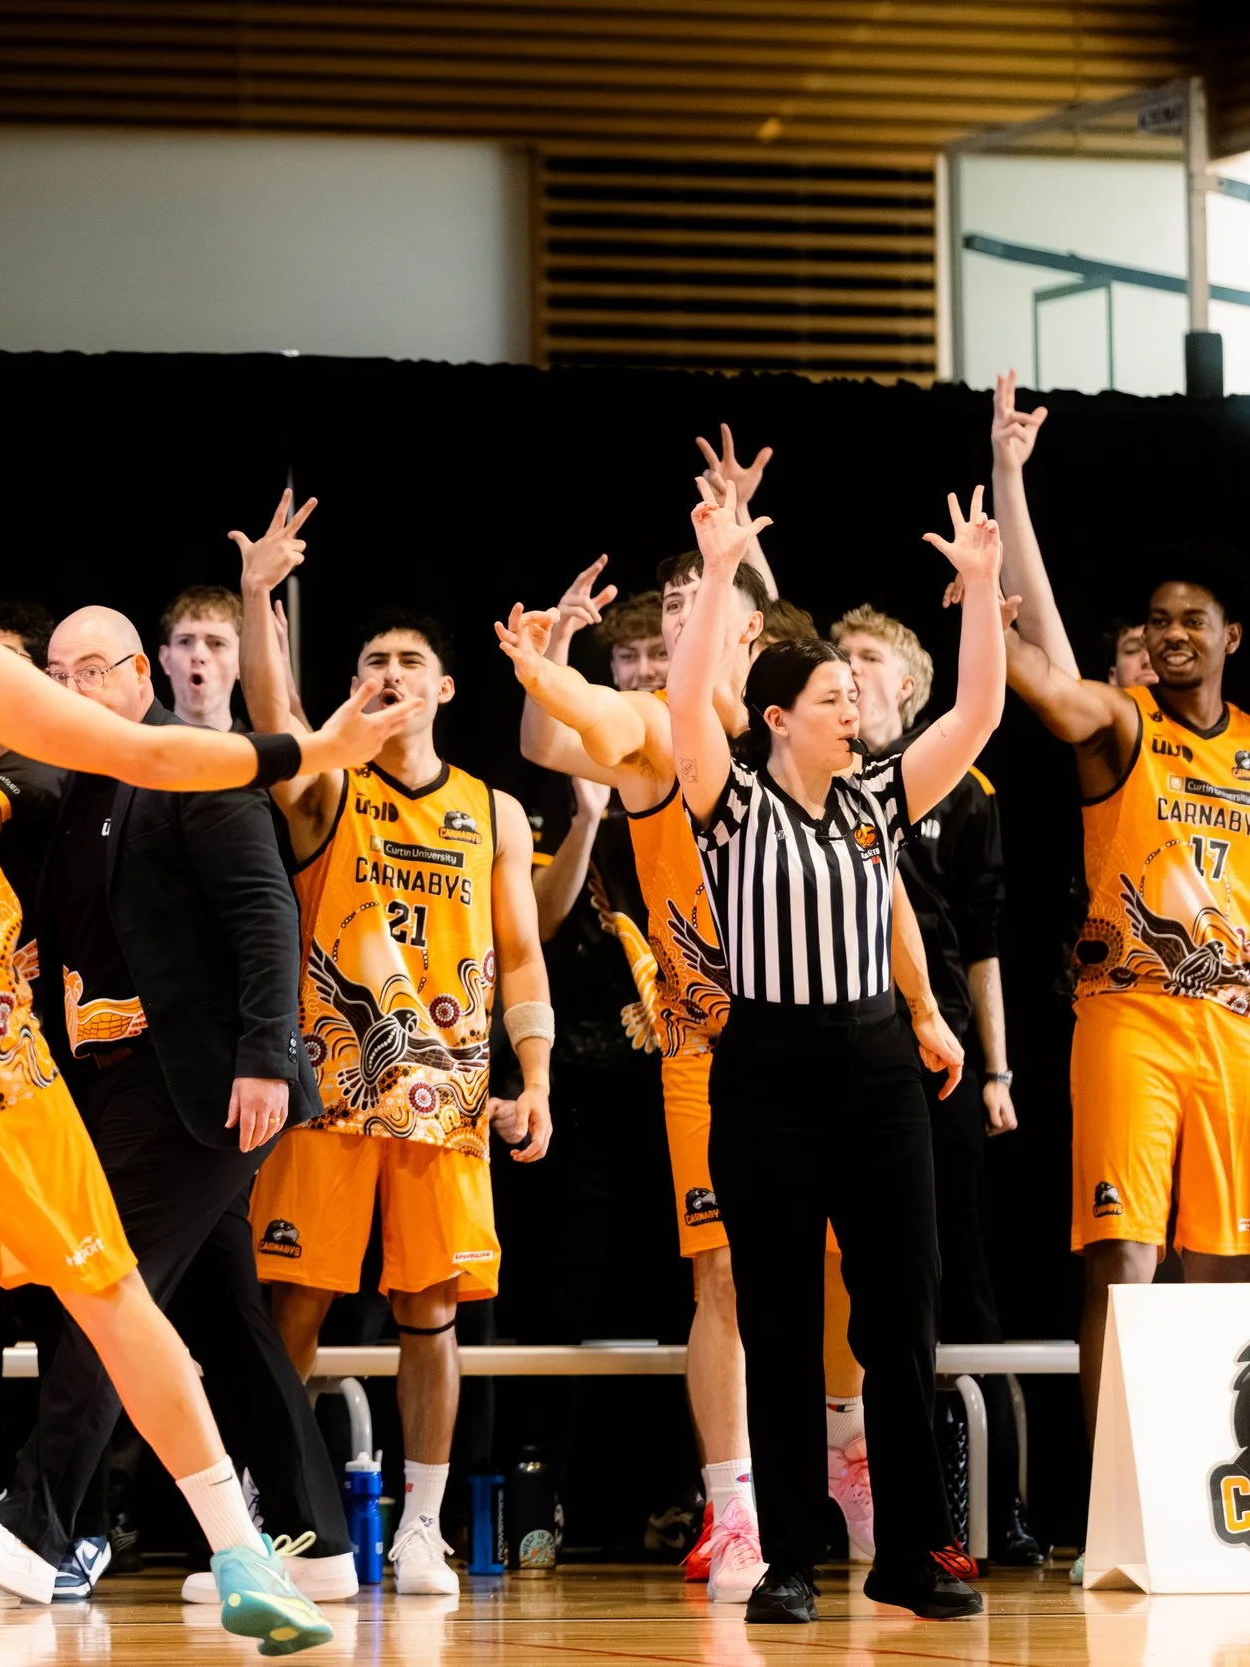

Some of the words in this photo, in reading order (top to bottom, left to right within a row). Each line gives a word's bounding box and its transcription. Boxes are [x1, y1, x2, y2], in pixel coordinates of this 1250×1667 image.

[385, 843, 412, 857] Curtin
[412, 849, 457, 864] University
[1191, 835, 1230, 879] 17
[355, 856, 471, 906] CARNABYS
[387, 900, 428, 948] 21
[685, 1209, 719, 1225] CARNABY
